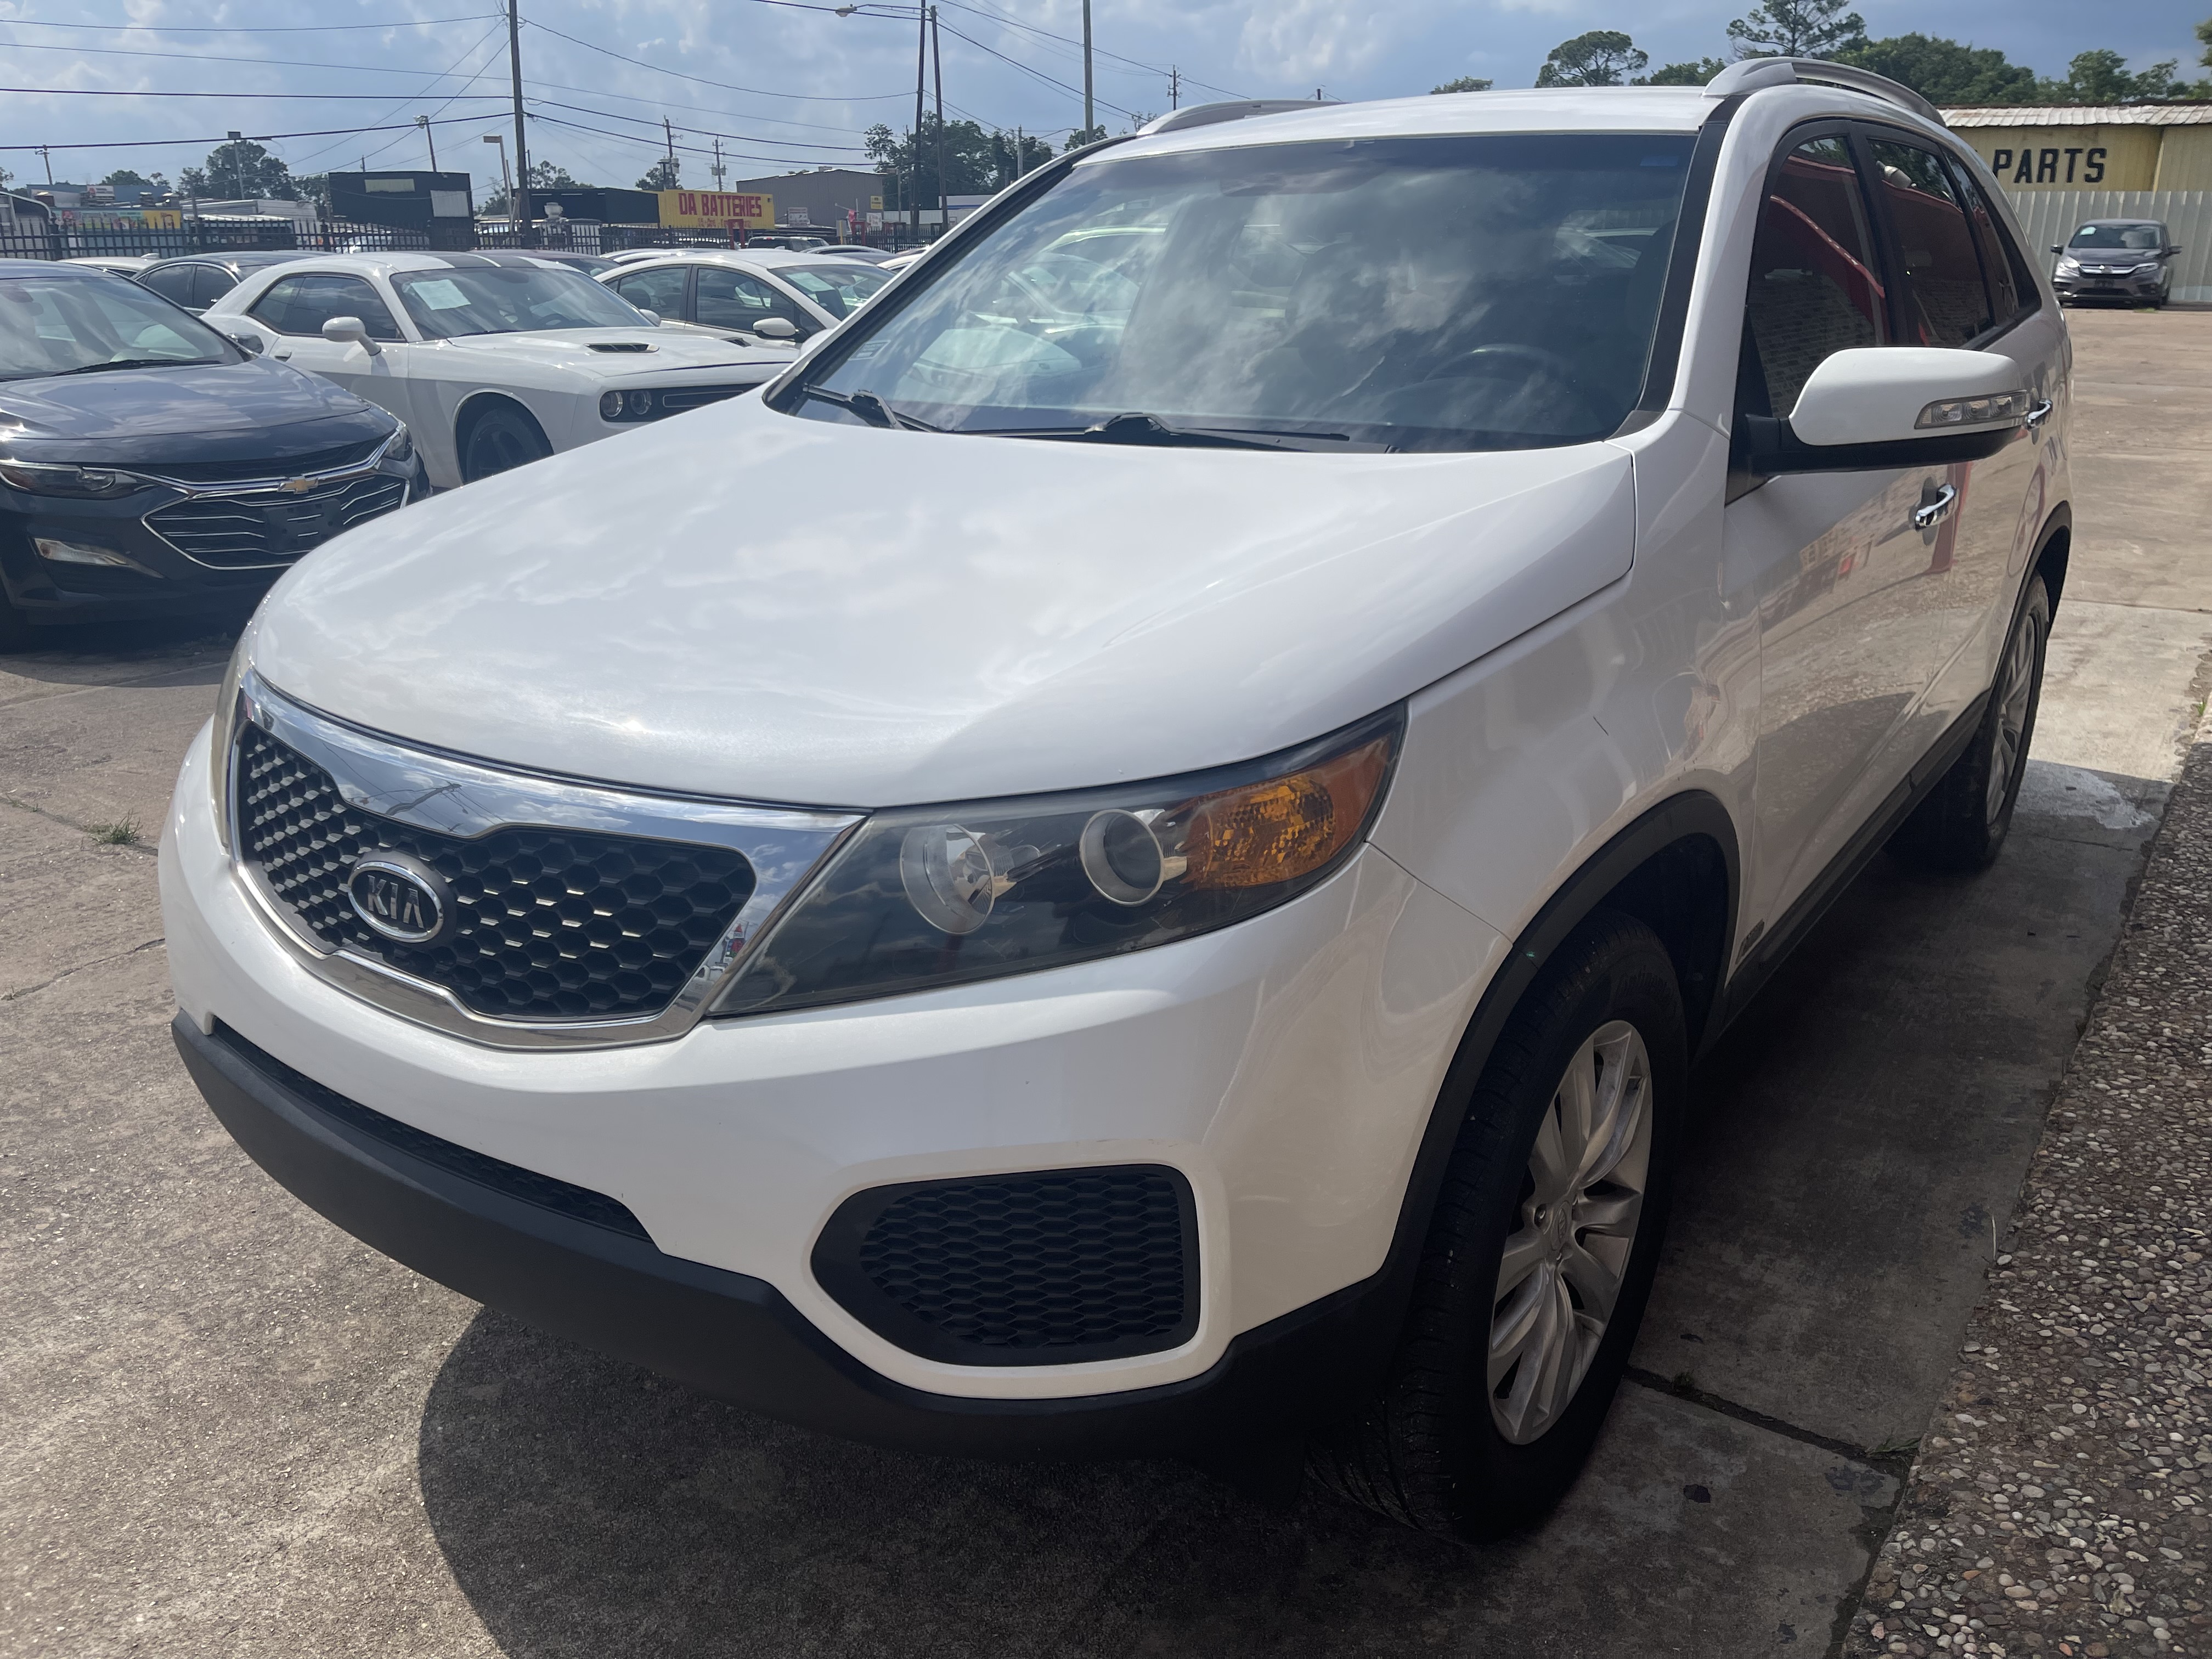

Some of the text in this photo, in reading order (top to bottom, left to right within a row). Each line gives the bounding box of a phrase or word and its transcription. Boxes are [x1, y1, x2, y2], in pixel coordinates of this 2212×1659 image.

[1992, 148, 2107, 183] PARTS
[678, 193, 697, 216] DA
[701, 194, 762, 217] BATTERIES
[367, 874, 425, 929] KIA
